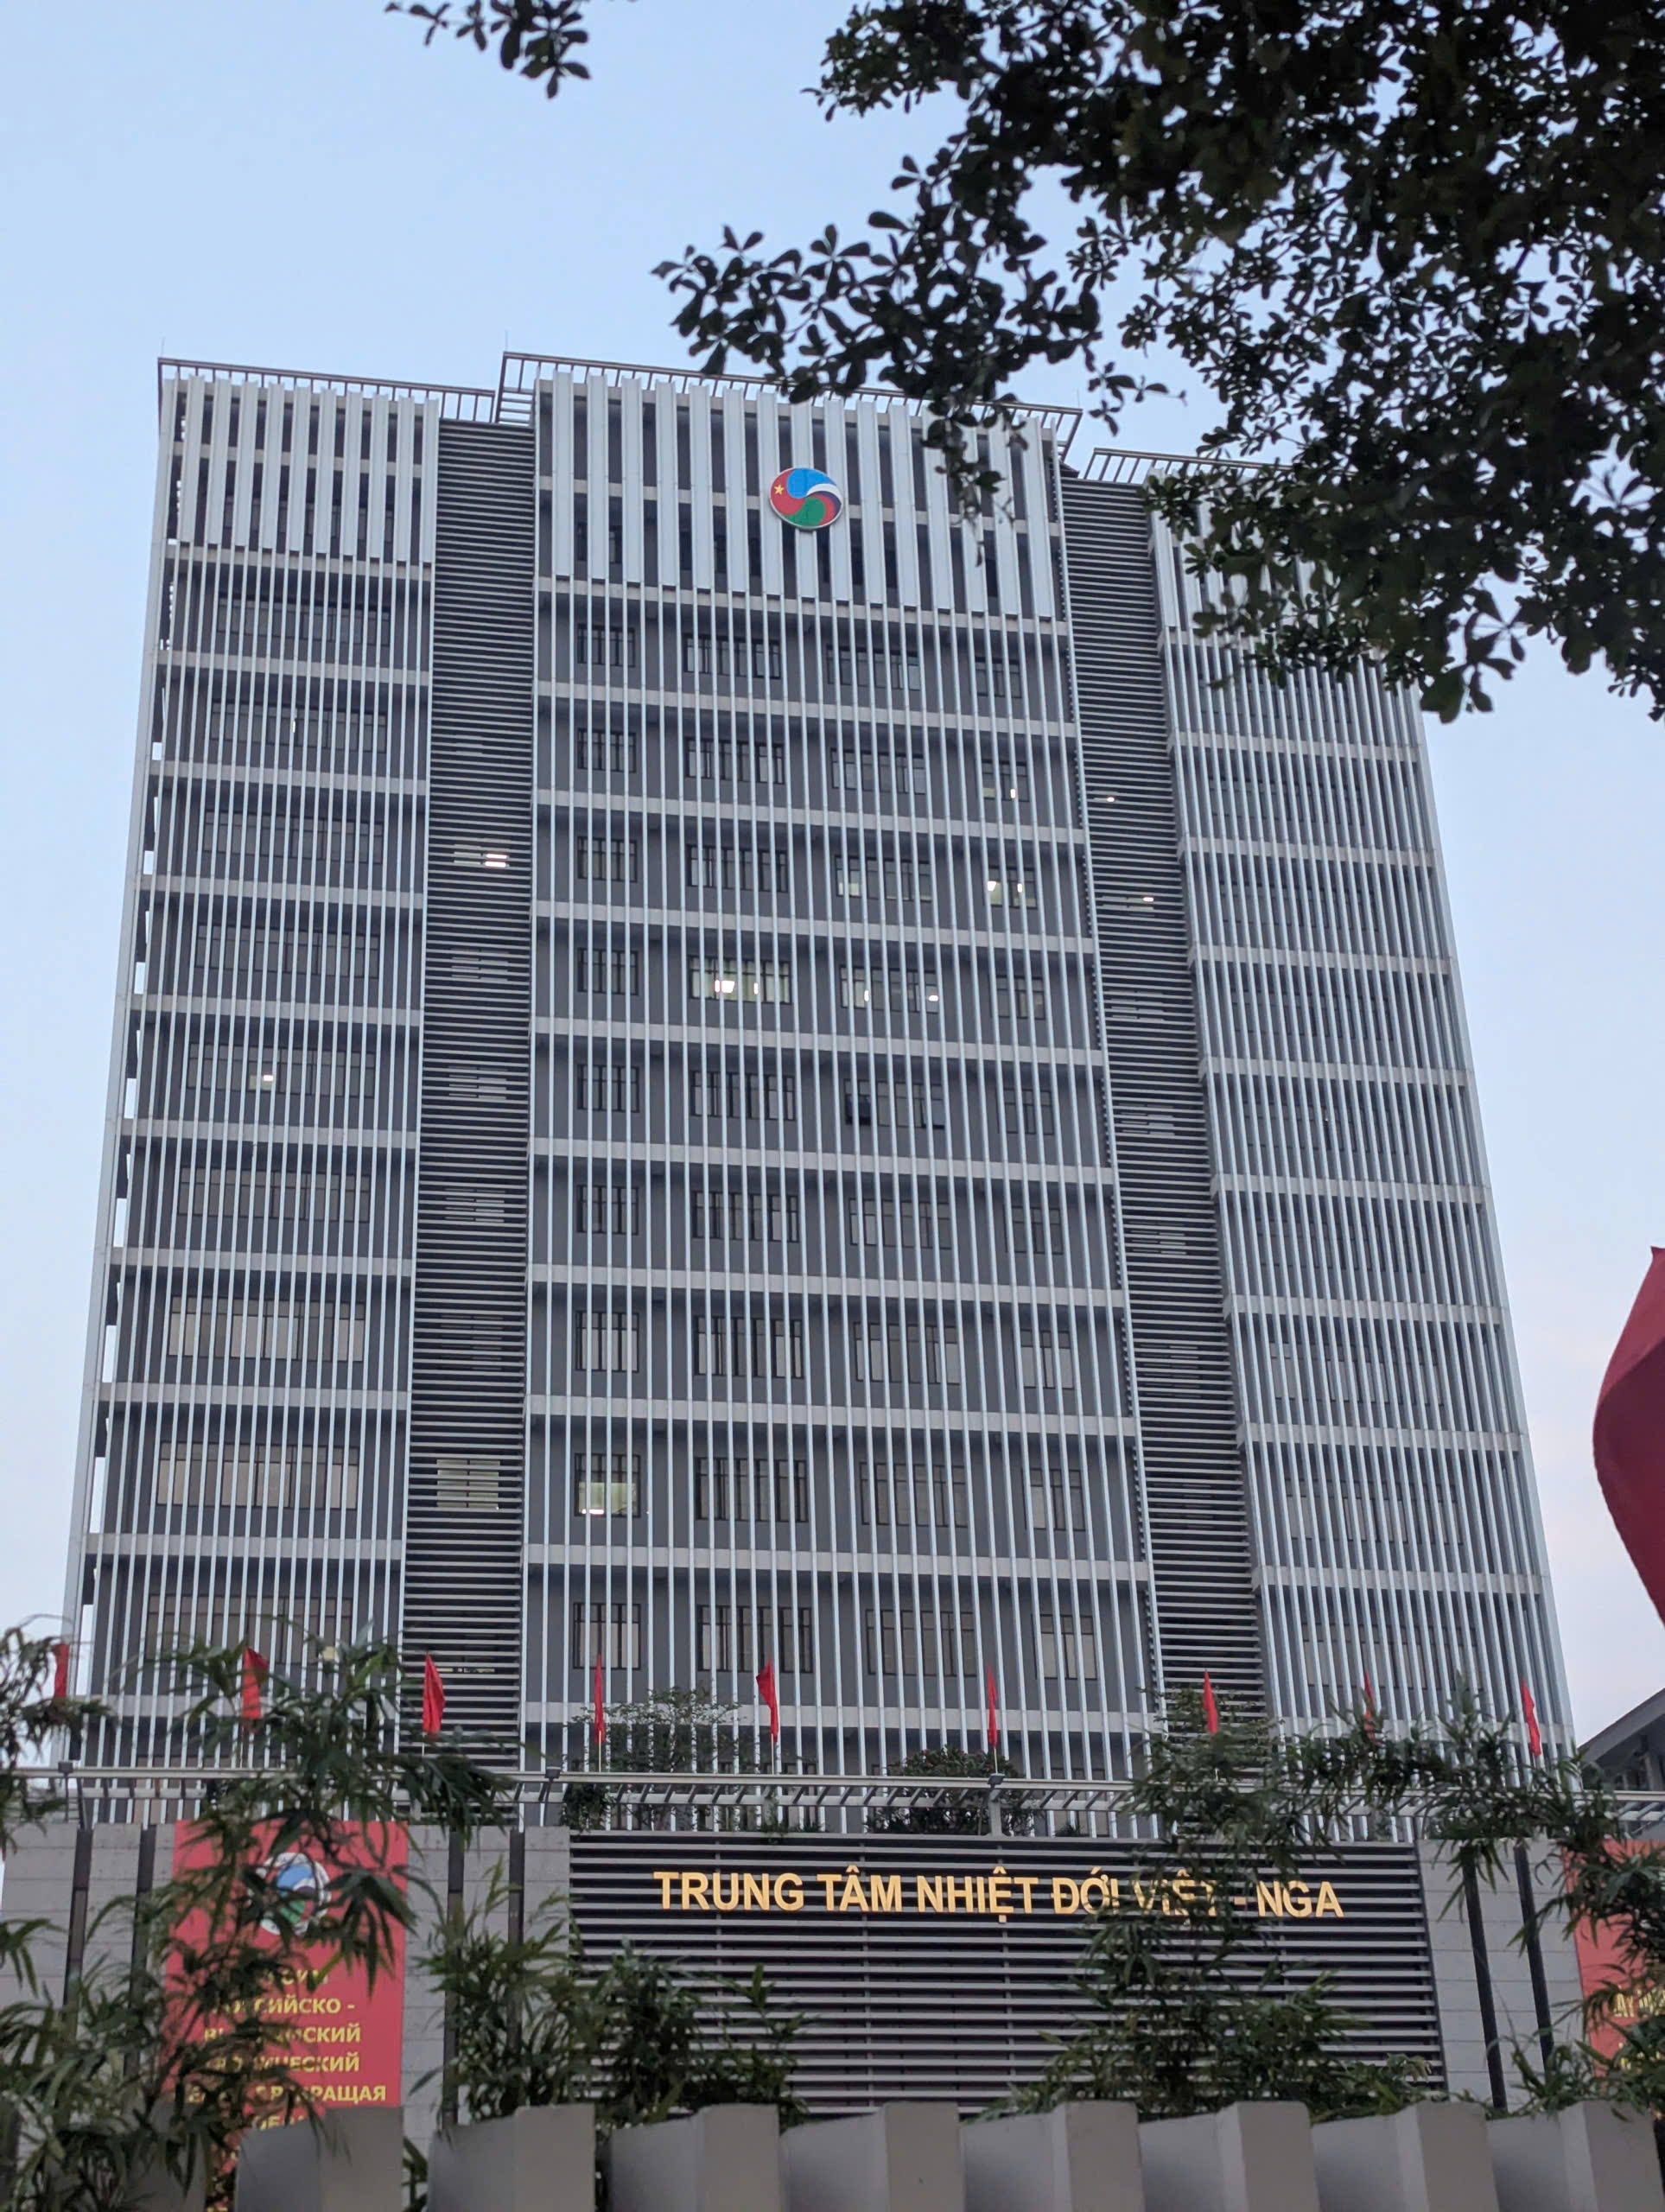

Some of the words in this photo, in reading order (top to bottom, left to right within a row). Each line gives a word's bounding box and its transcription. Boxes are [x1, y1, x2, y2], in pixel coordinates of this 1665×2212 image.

[653, 1871, 804, 1911] TRUNG
[817, 1865, 903, 1913] TÂM
[917, 1866, 1039, 1923] NHIỆT
[1051, 1866, 1120, 1916] ĐỚI
[1234, 1897, 1247, 1905] -
[1256, 1880, 1344, 1917] NGA
